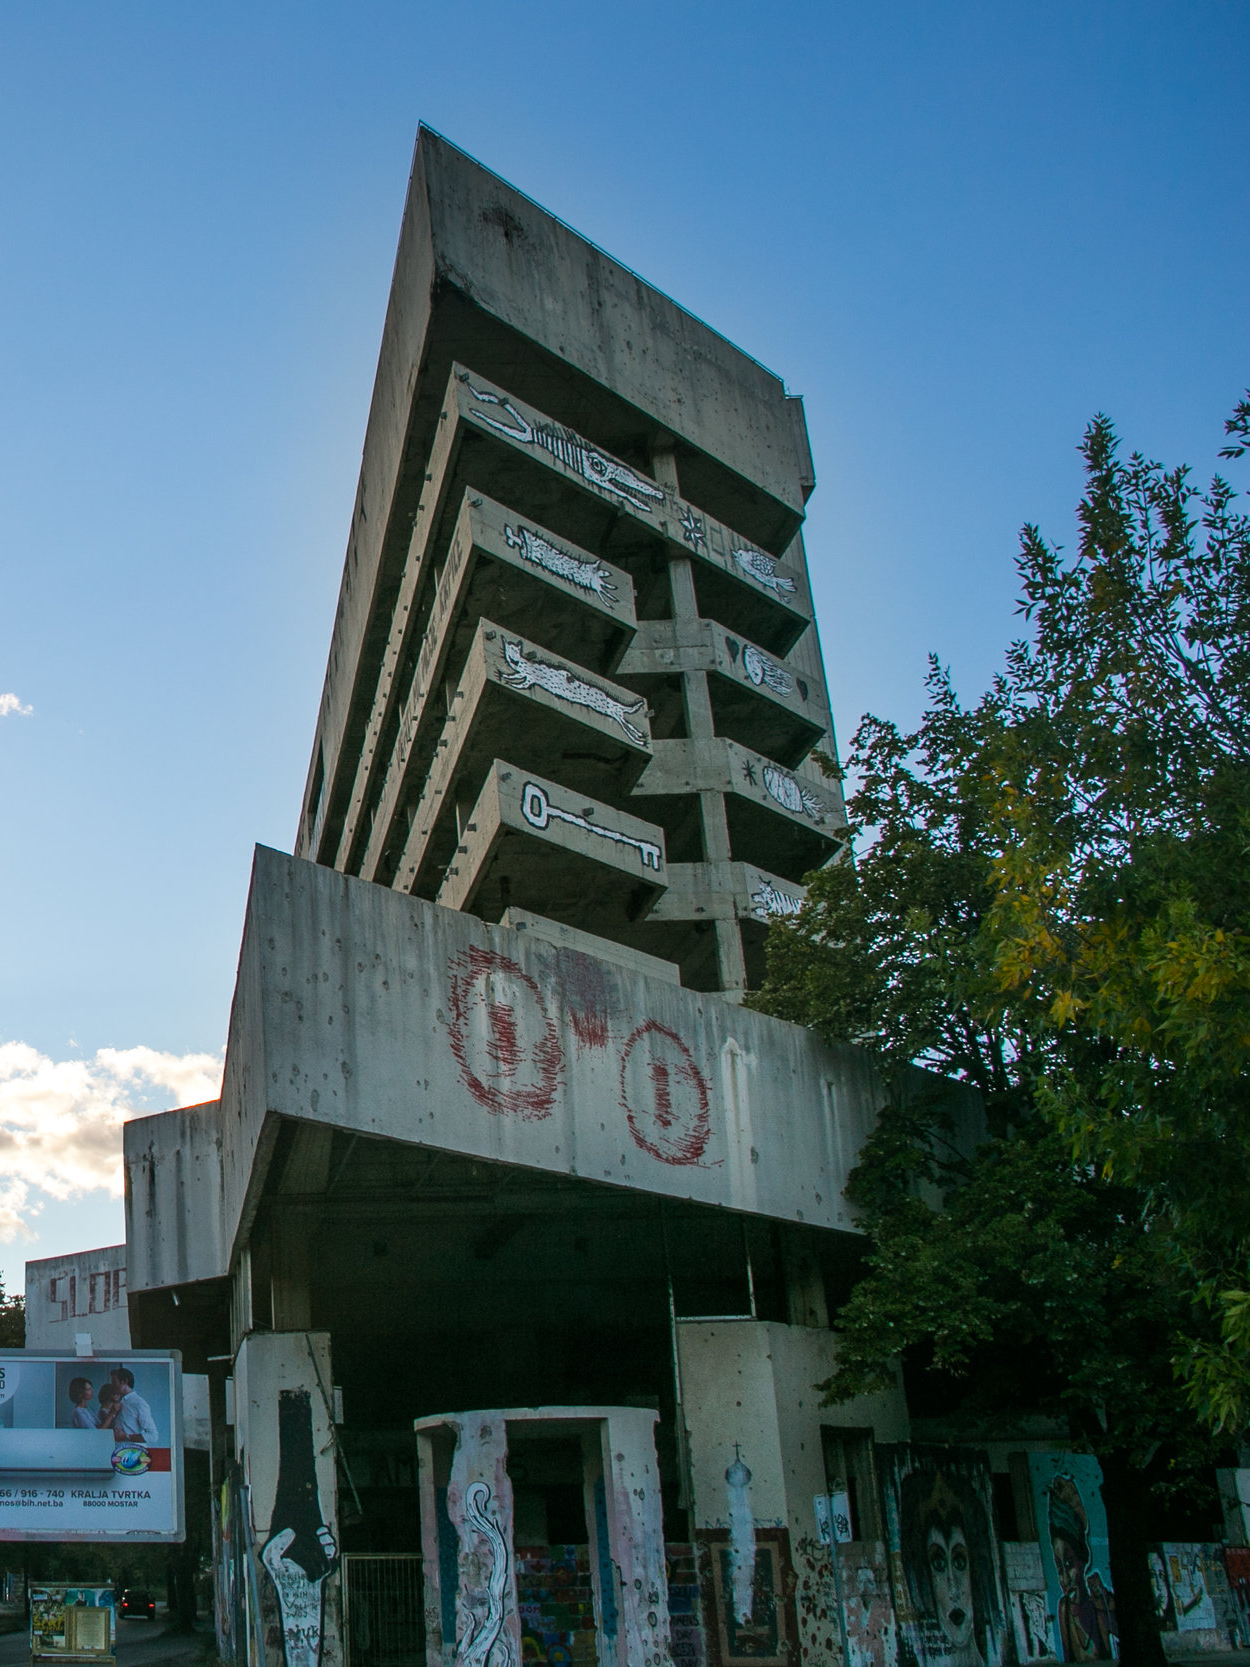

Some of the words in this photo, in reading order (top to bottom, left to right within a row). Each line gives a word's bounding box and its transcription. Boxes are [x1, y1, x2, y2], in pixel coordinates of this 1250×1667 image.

[0, 1489, 12, 1498] 66
[21, 1489, 38, 1498] 916
[47, 1490, 65, 1499] 740
[70, 1490, 108, 1499] KRALJA
[111, 1490, 151, 1500] TVRTKA
